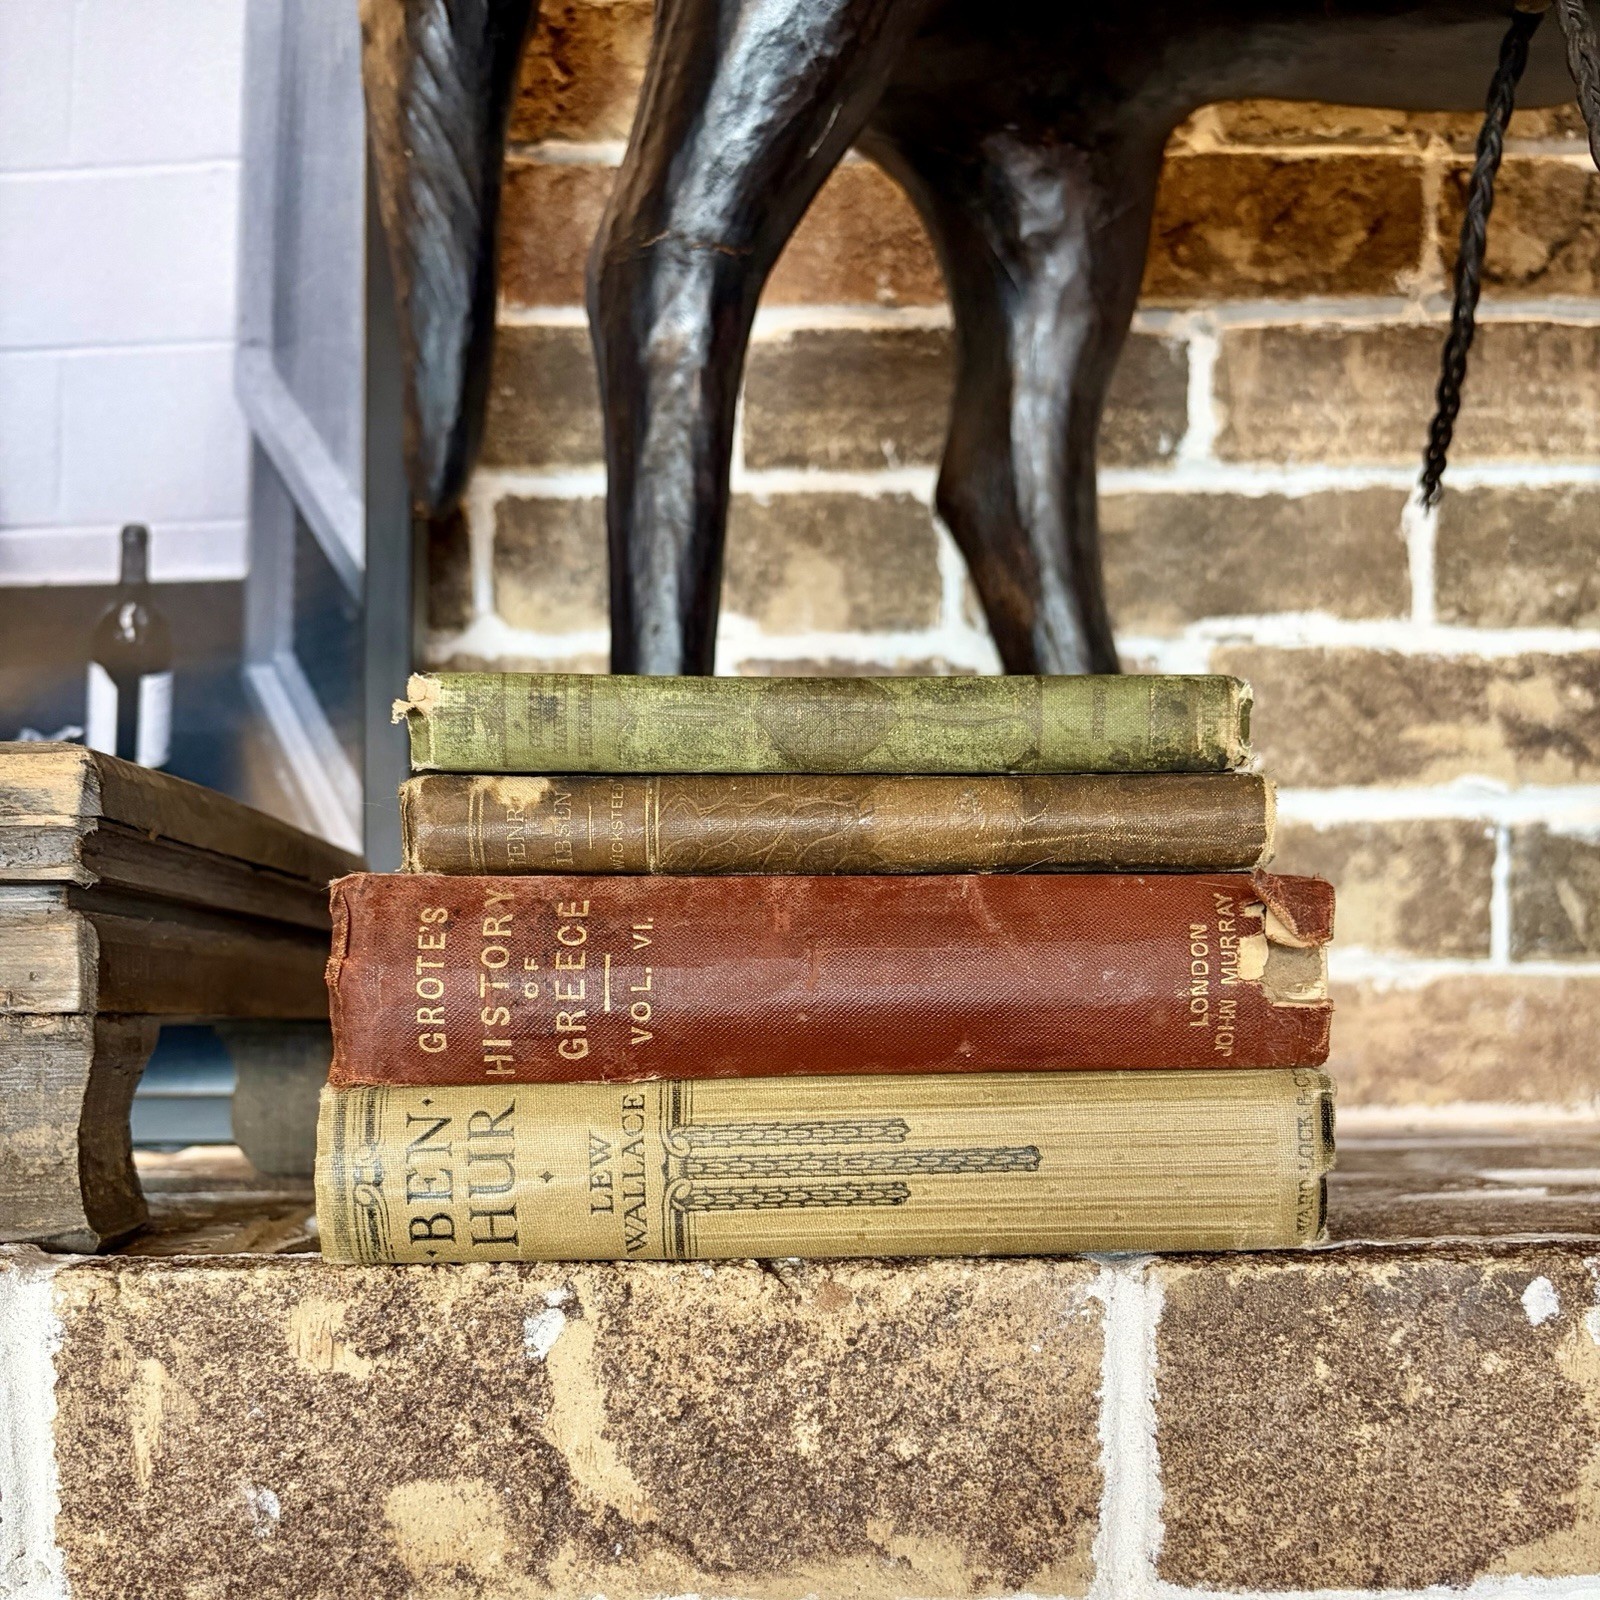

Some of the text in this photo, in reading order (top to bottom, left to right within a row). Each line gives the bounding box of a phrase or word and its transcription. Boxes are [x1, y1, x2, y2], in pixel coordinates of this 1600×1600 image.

[555, 791, 573, 865] IBSEN
[416, 908, 448, 1053] GROTE'S
[480, 888, 515, 1075] HISTORY
[523, 957, 539, 999] OF
[555, 900, 590, 1060] GREECE
[631, 917, 655, 1045] VOL. VI.
[1190, 924, 1209, 1027] LONDON
[1213, 893, 1238, 1057] JOHN MURRAY
[406, 1112, 456, 1245] BEN
[468, 1098, 520, 1247] HUR
[588, 1129, 614, 1215] LEW
[622, 1093, 648, 1254] WALLACE
